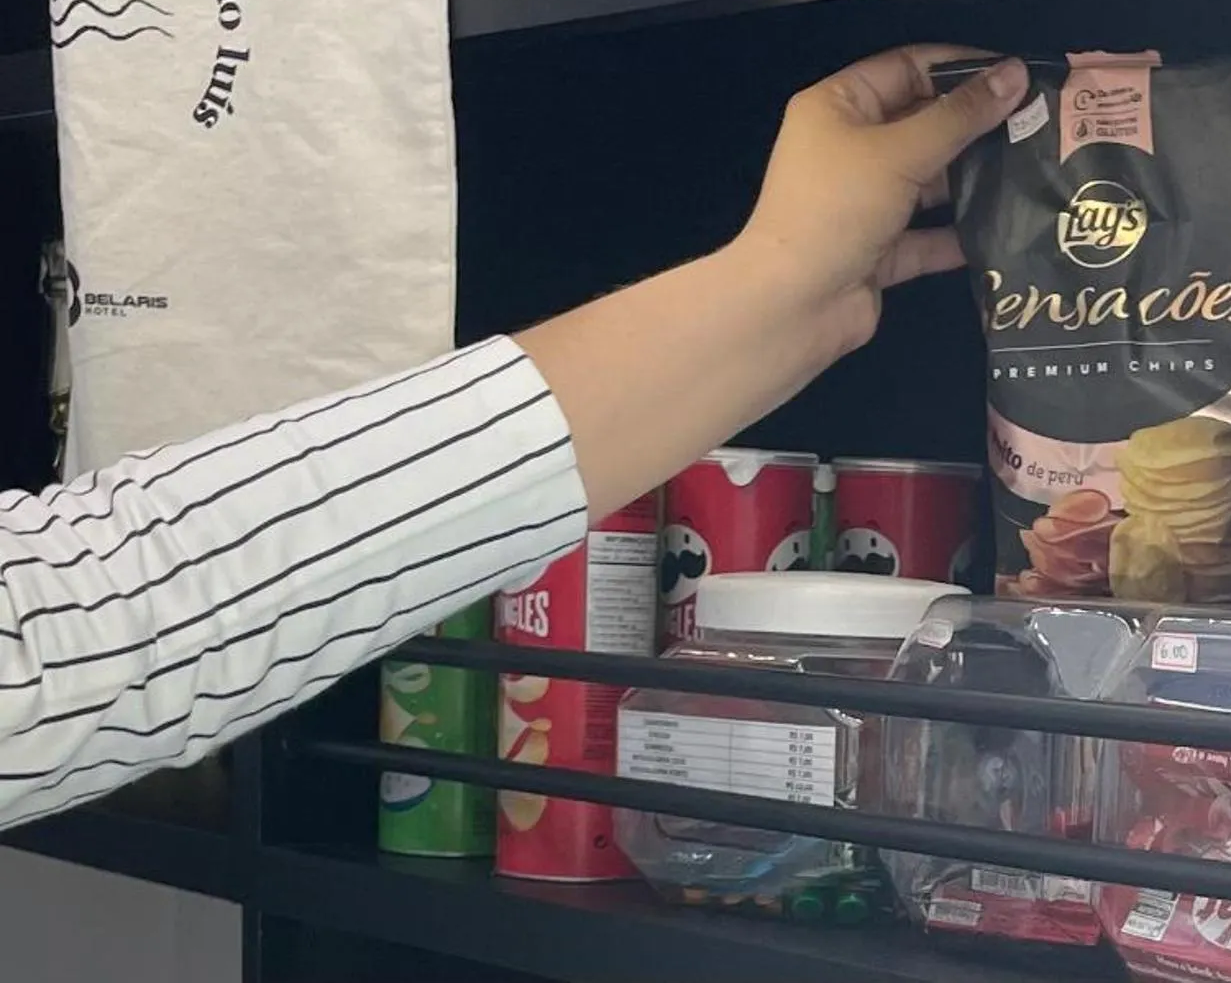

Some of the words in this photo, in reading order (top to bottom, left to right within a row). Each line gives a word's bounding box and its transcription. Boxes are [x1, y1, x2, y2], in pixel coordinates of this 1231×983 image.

[193, 45, 250, 129] luís
[1064, 202, 1142, 247] Lay's
[84, 293, 168, 309] BELARIS
[84, 306, 128, 317] HOTEL
[992, 362, 1109, 379] PREMIUM
[1129, 359, 1215, 372] CHIPS
[1026, 461, 1045, 479] de
